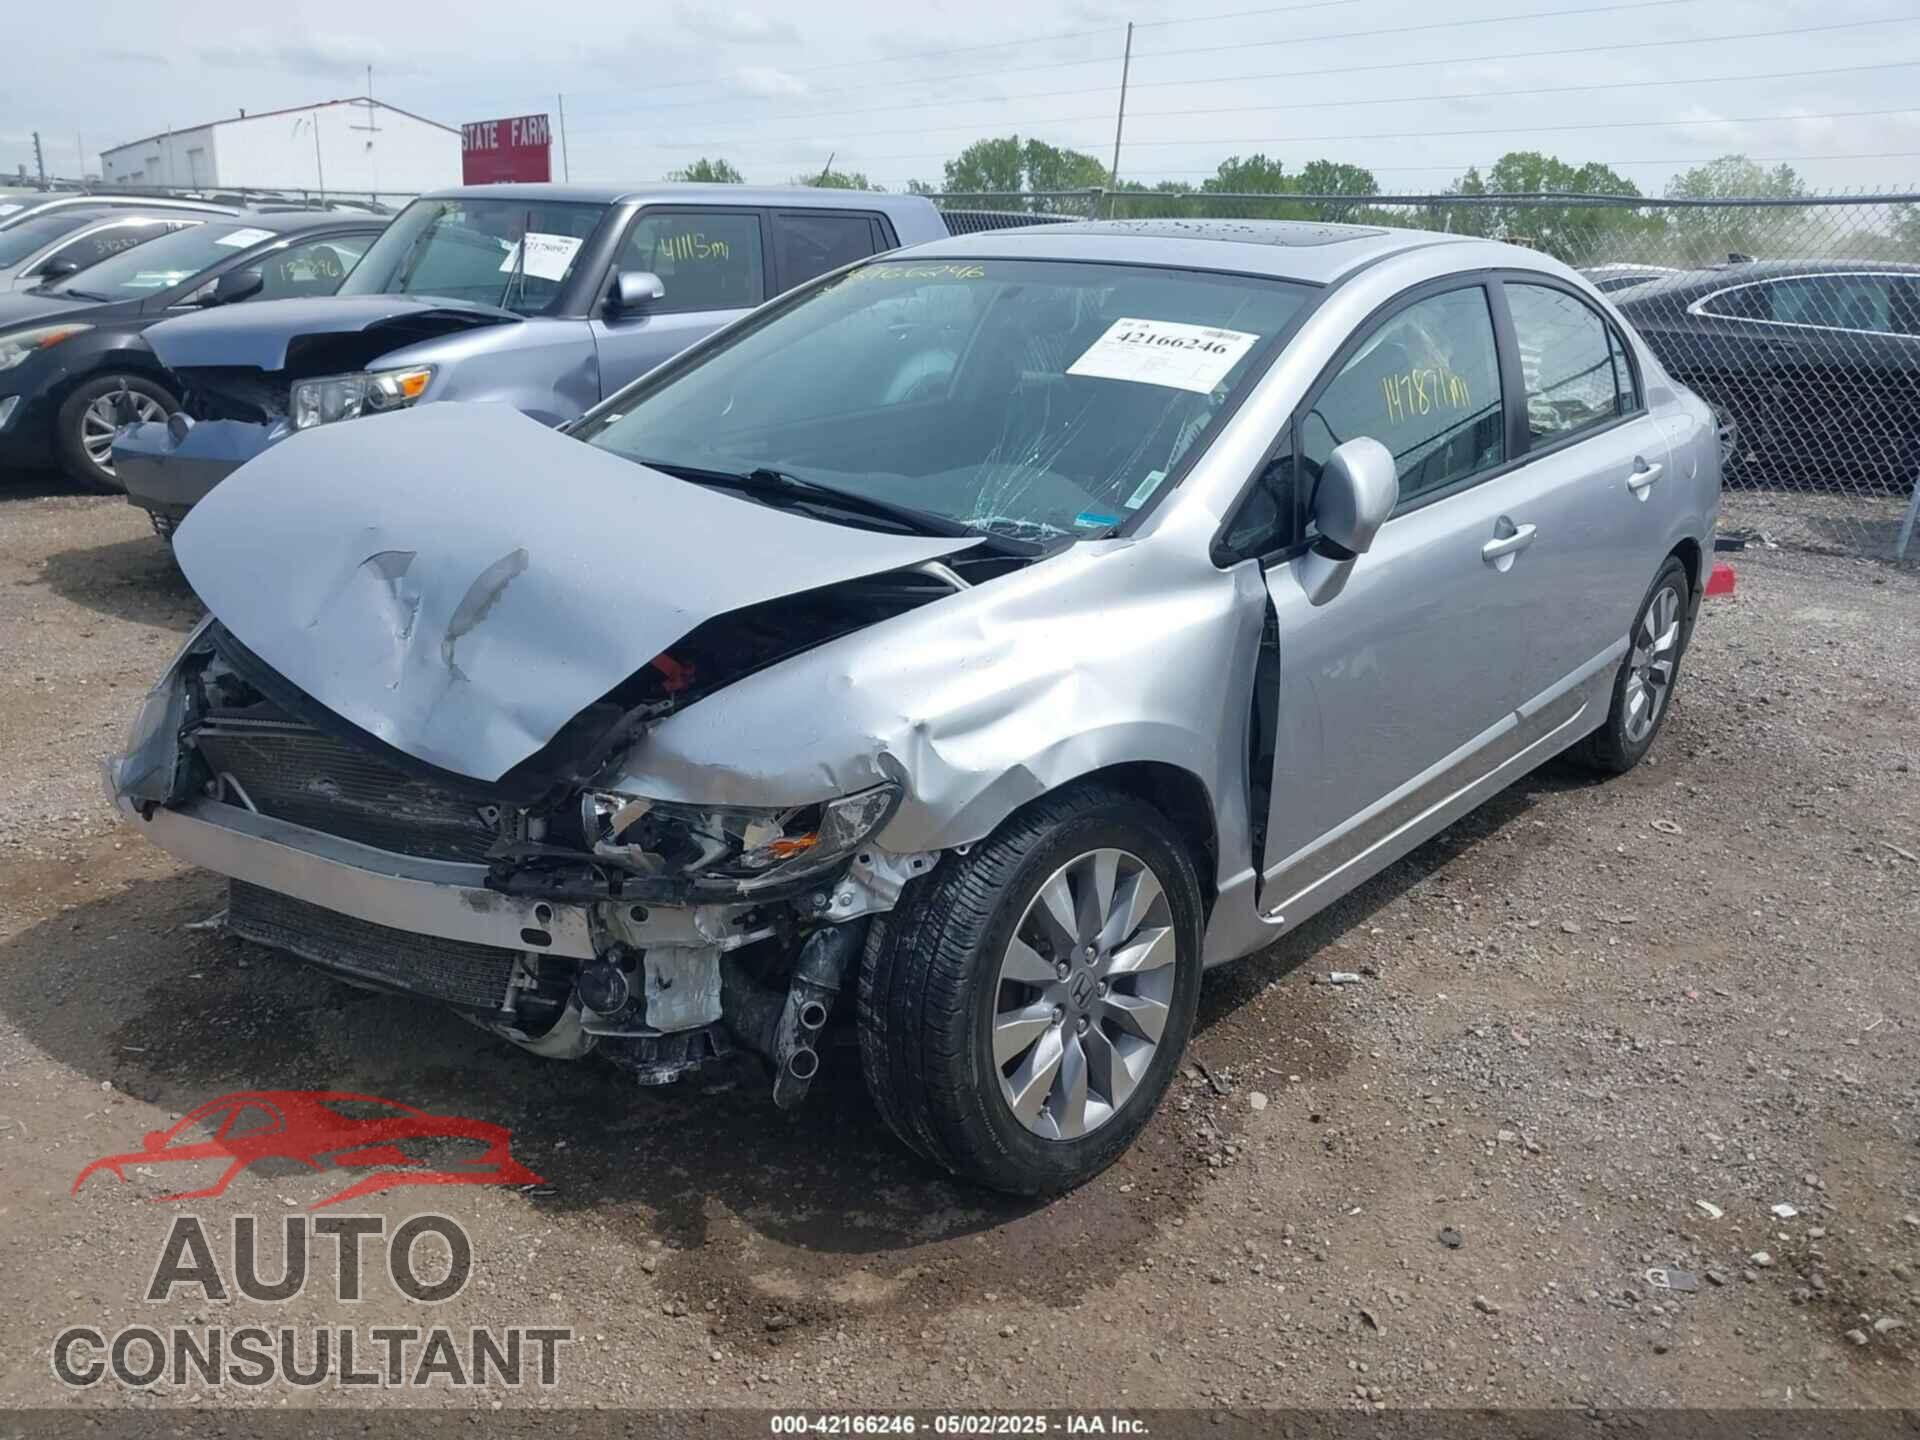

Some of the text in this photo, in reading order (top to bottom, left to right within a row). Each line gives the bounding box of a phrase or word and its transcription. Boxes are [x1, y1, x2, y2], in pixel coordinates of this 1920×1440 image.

[462, 116, 548, 150] STATE FARM
[1116, 331, 1227, 355] 42166246
